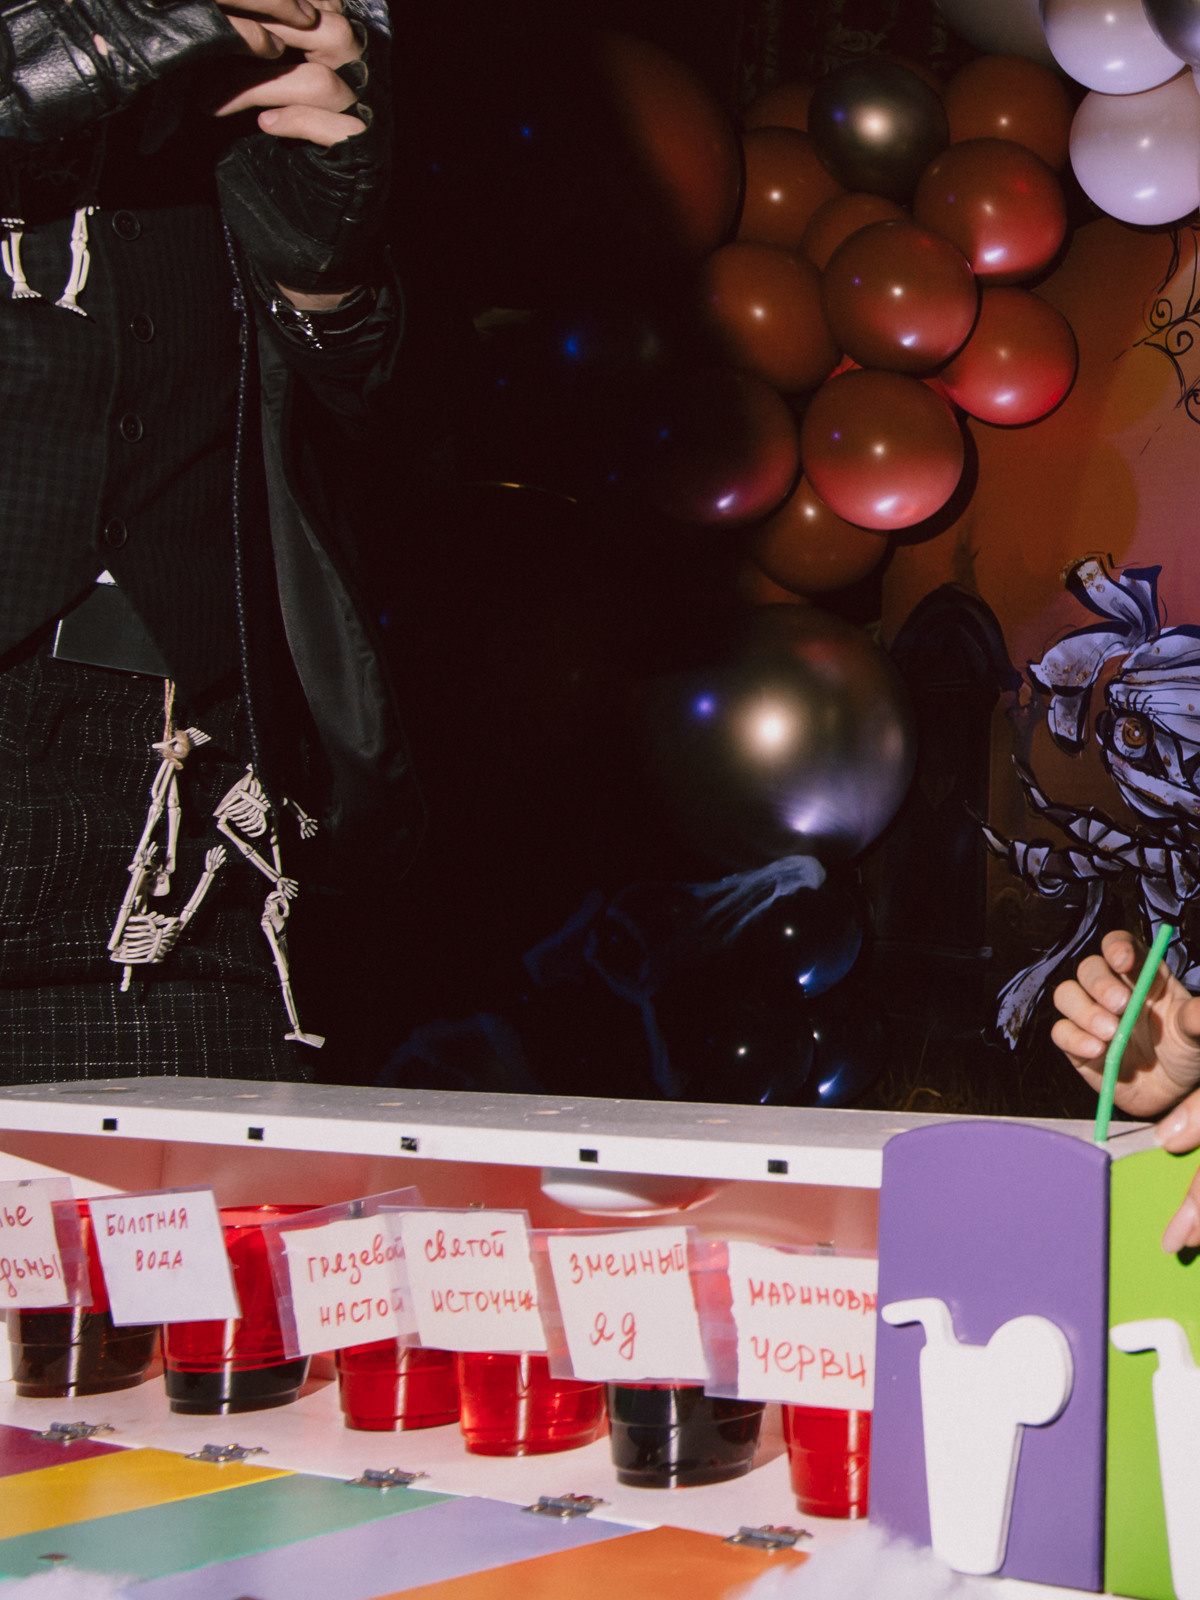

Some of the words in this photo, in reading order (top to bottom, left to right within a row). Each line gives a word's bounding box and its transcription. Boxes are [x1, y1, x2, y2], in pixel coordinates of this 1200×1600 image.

[0, 1205, 33, 1228] ье
[106, 1207, 189, 1237] БОЛОТНАЯ
[135, 1249, 183, 1272] ВОДА
